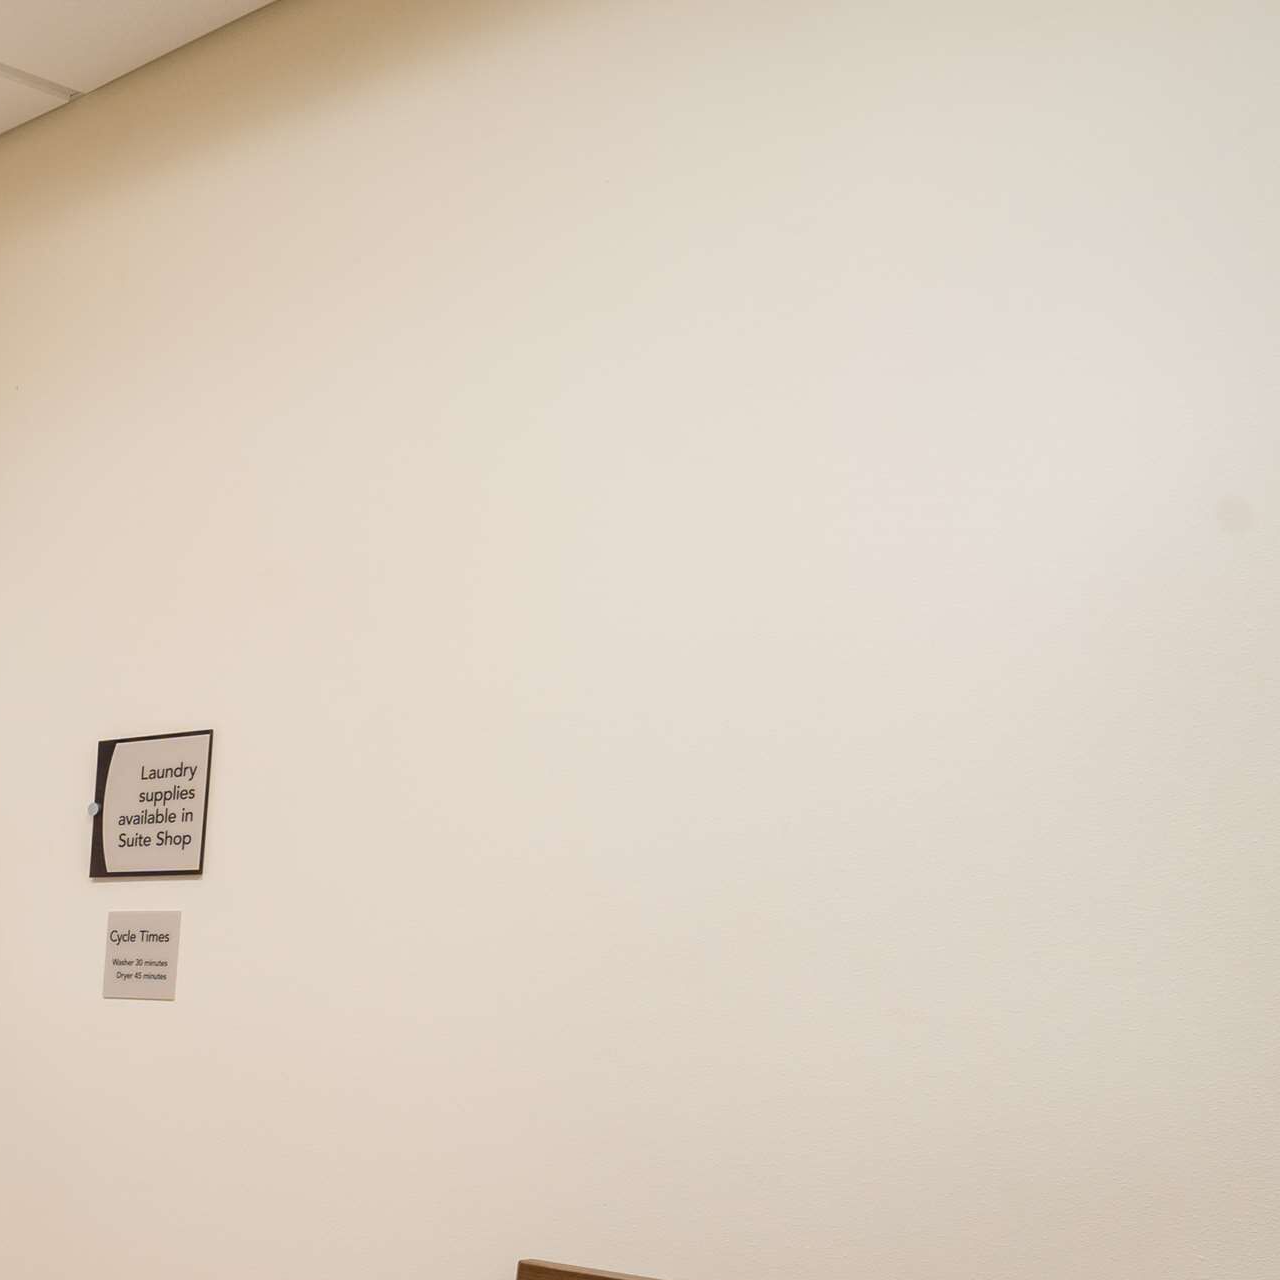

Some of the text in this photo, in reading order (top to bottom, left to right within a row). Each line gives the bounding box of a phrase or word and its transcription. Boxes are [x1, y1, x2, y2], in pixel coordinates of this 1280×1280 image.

[141, 762, 198, 781] Laundry
[139, 785, 196, 806] supplies
[118, 808, 193, 826] available in
[118, 830, 192, 850] Suite Shop
[110, 930, 169, 946] Cycle Times
